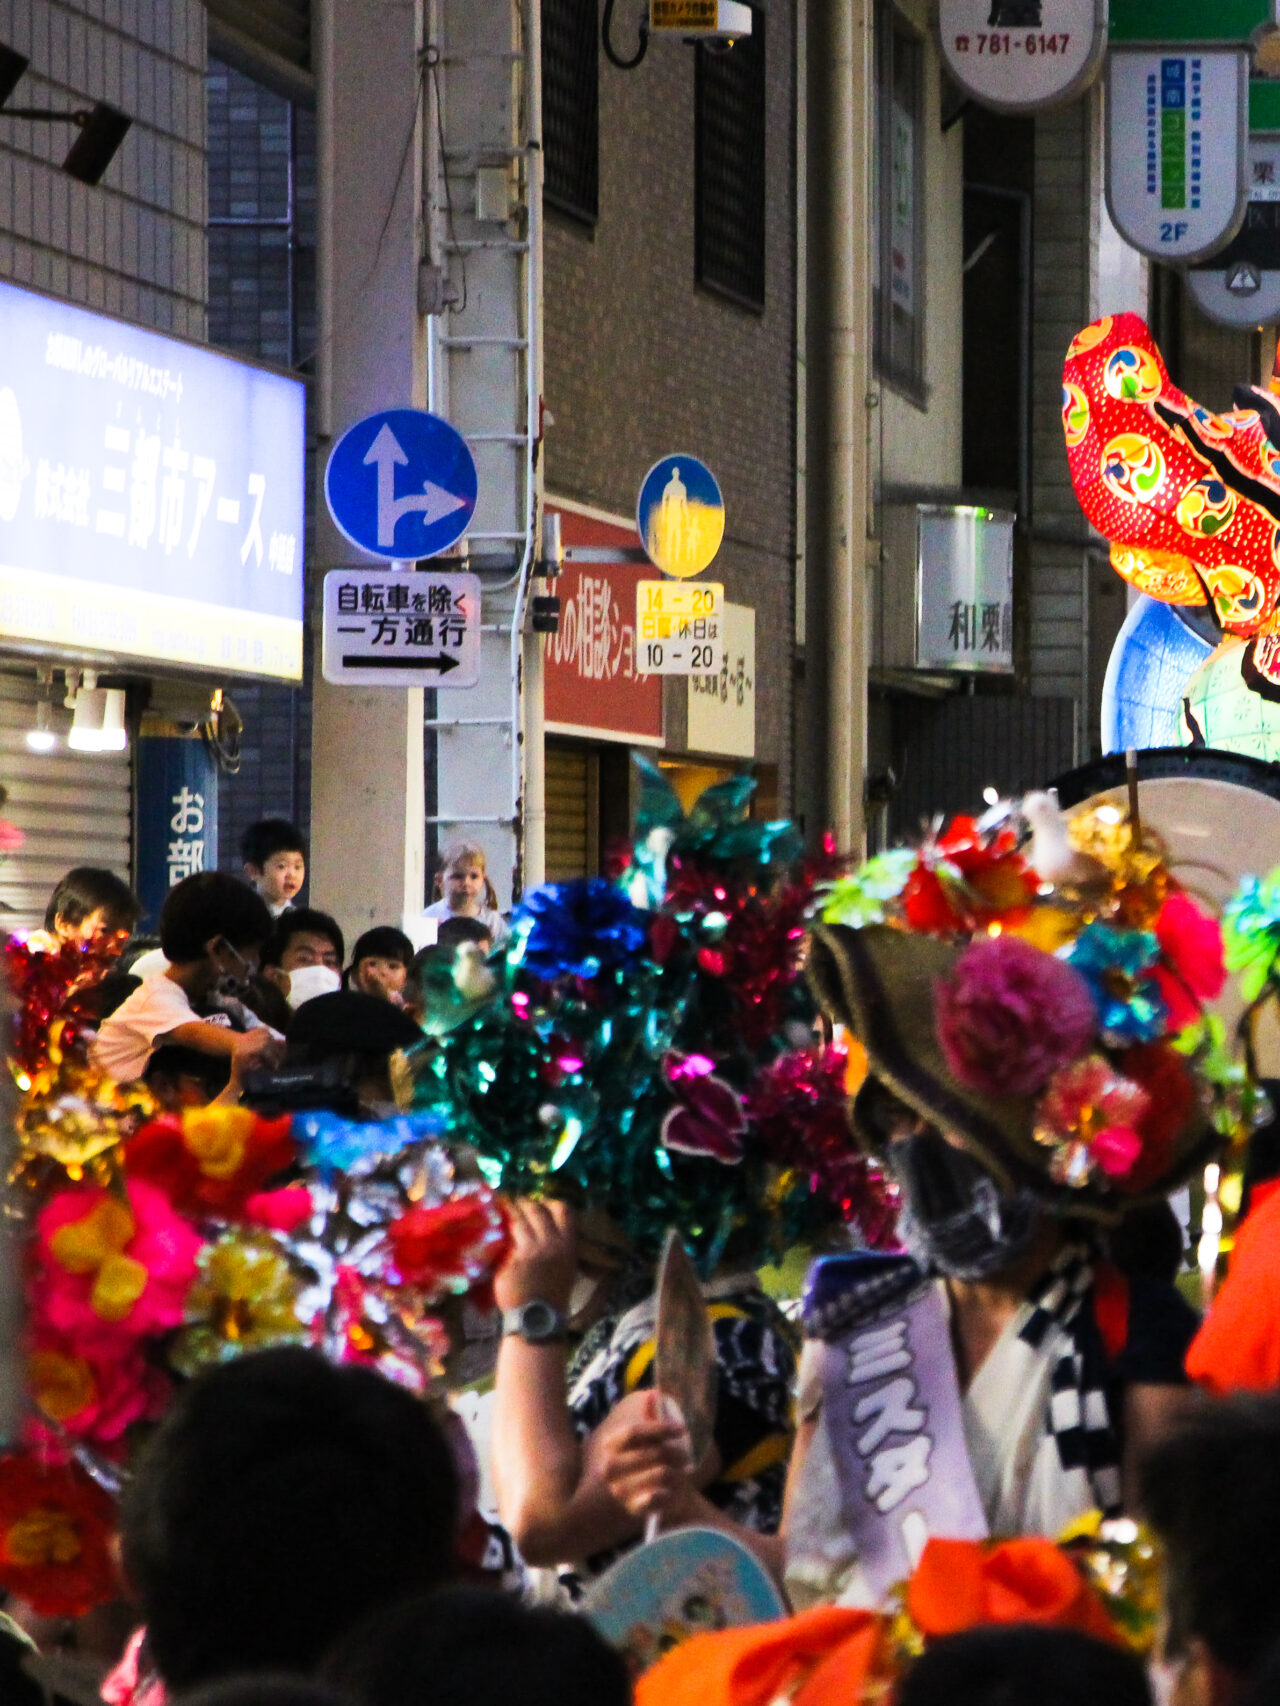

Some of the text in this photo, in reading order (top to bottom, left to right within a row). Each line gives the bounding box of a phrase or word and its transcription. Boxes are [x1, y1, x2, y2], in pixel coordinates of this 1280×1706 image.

[977, 34, 1070, 55] 781-6147
[1160, 222, 1188, 241] 2F
[96, 424, 266, 568] 三都市アース
[338, 583, 467, 612] 自転車を除く
[337, 617, 467, 646] 一方通行
